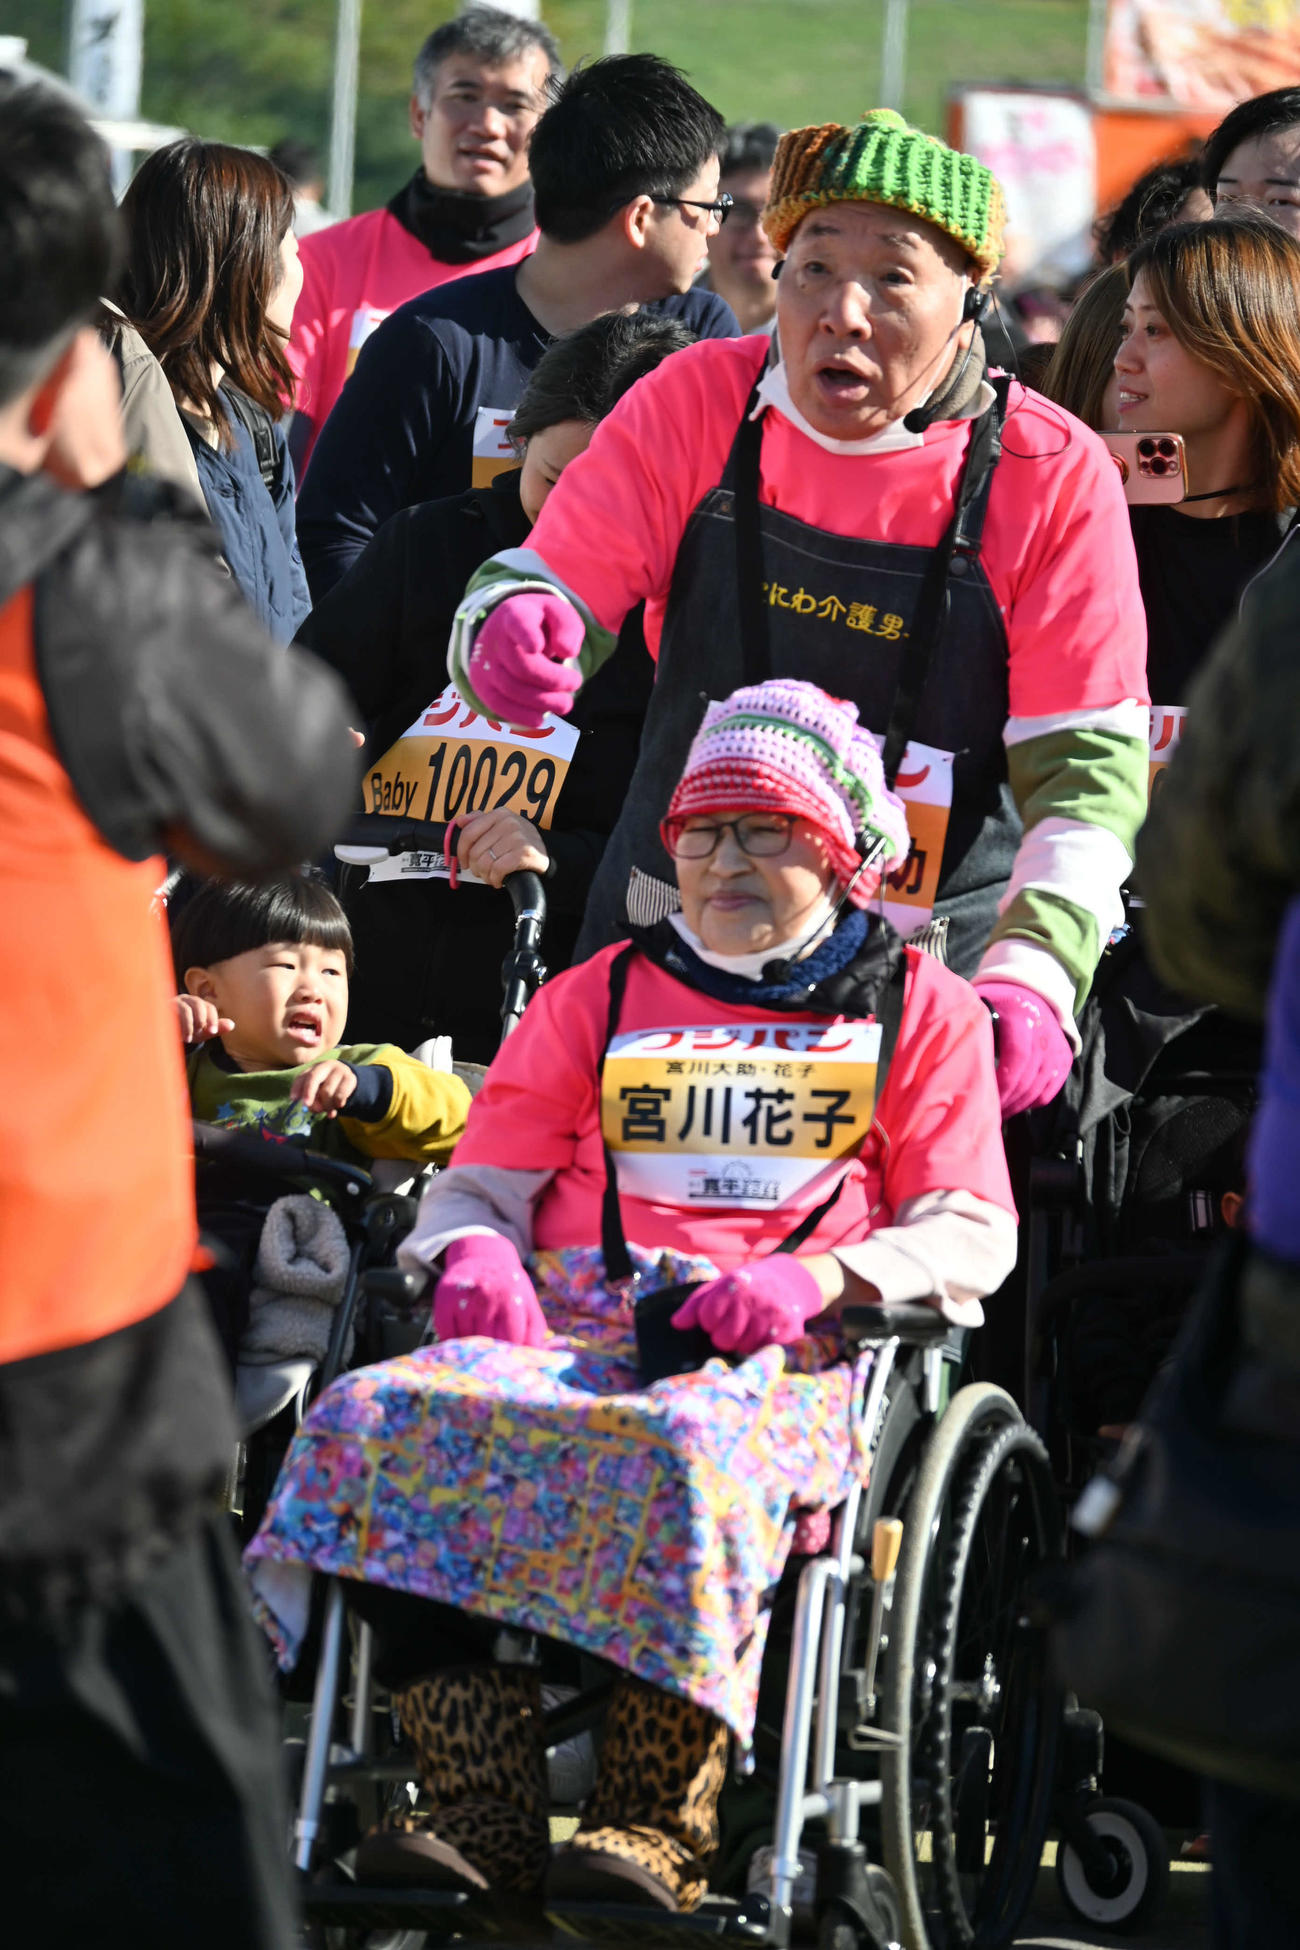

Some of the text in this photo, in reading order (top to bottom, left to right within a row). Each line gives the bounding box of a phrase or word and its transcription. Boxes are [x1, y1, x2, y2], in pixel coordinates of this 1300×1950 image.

[371, 742, 557, 824] Baby 10029
[619, 1083, 856, 1148] 宮川花子
